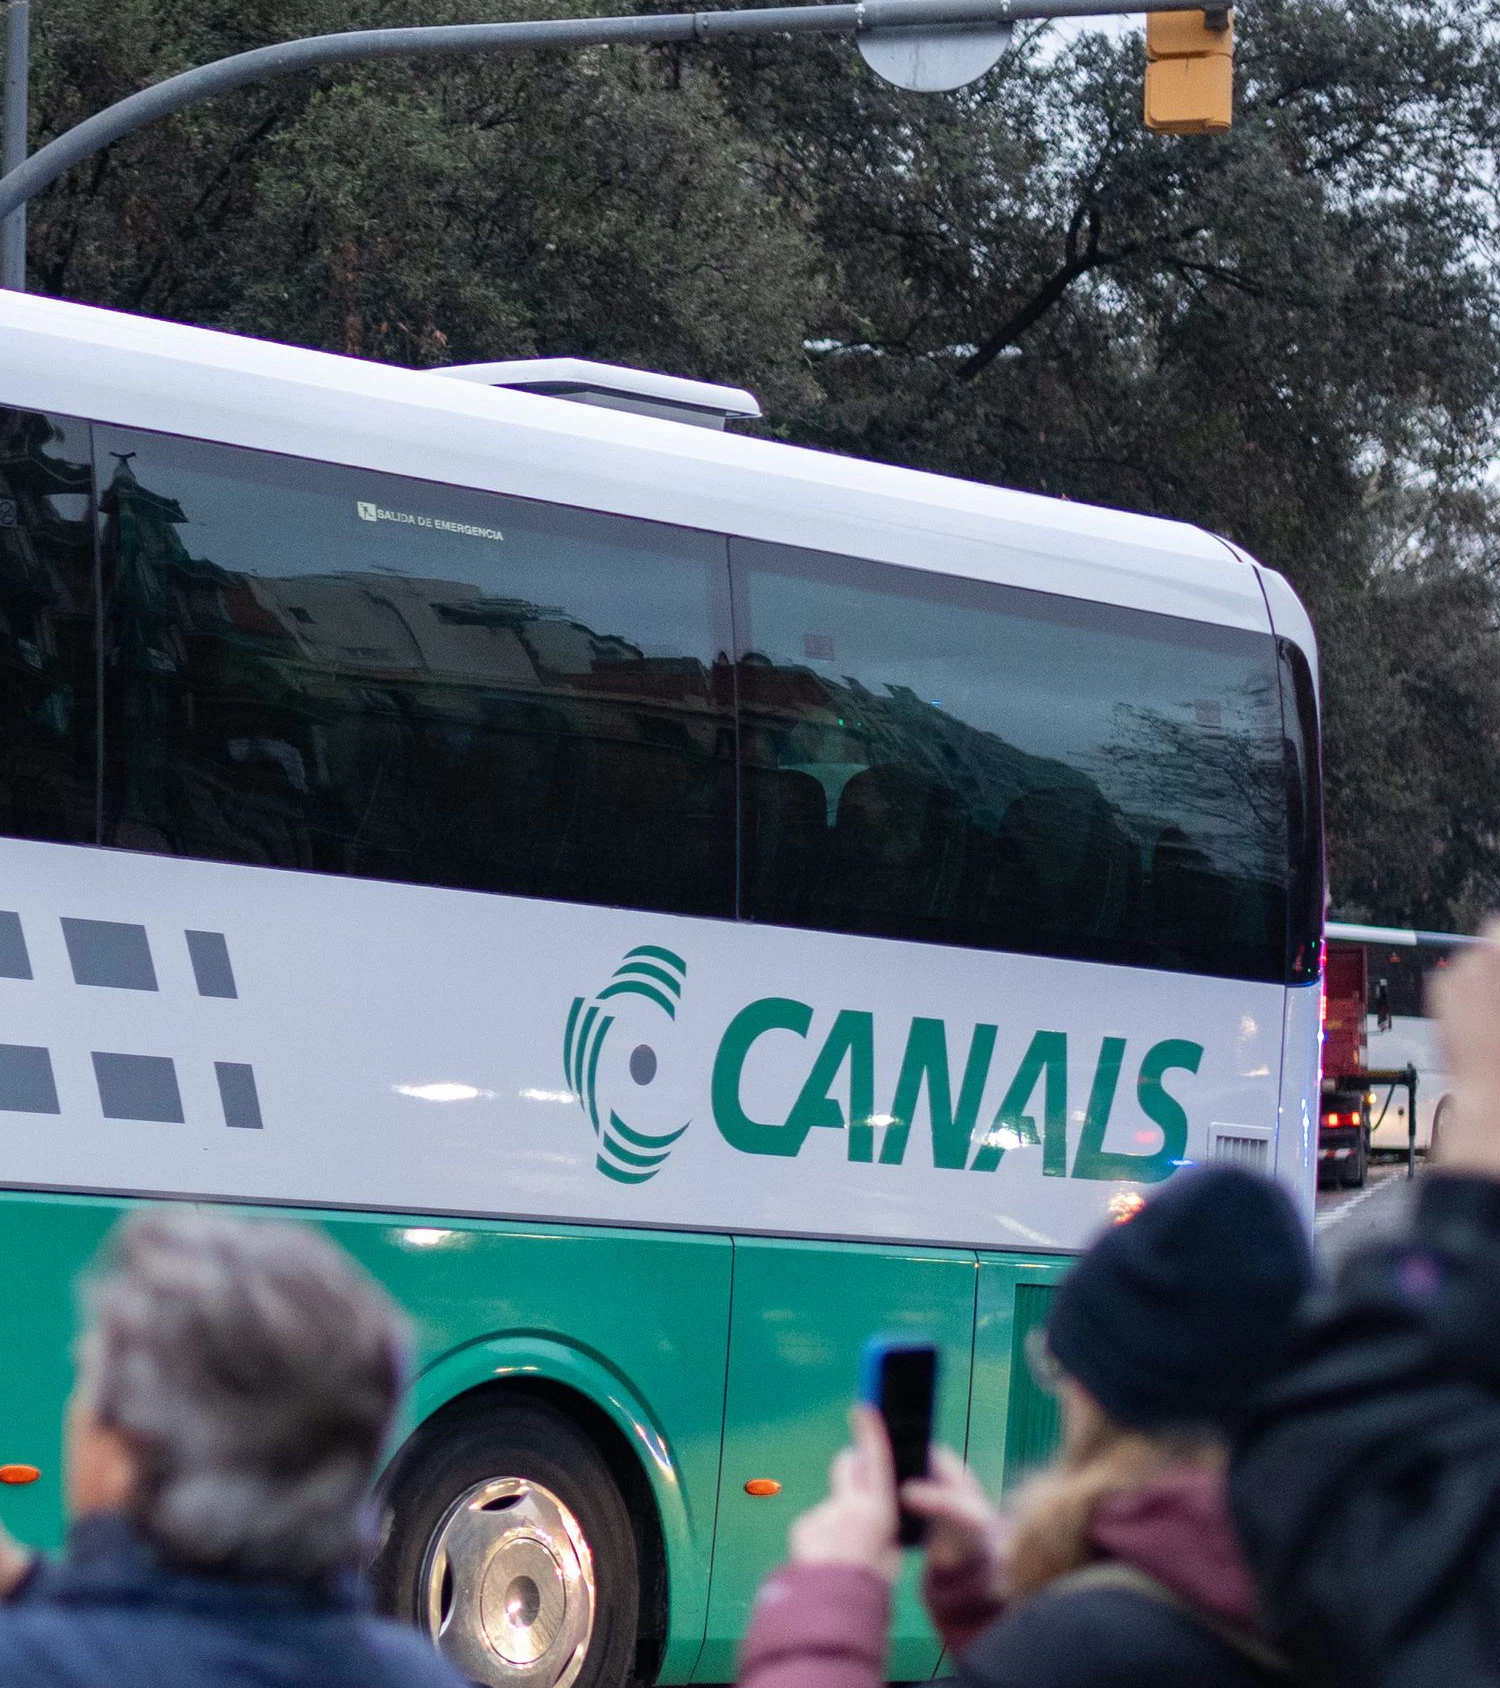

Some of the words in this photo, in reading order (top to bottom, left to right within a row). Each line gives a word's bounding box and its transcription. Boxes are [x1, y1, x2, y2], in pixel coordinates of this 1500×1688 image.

[376, 508, 416, 525] SALIDA
[417, 516, 433, 528] DE
[434, 519, 504, 541] EMERGENCIA
[711, 997, 1205, 1184] CANALS
